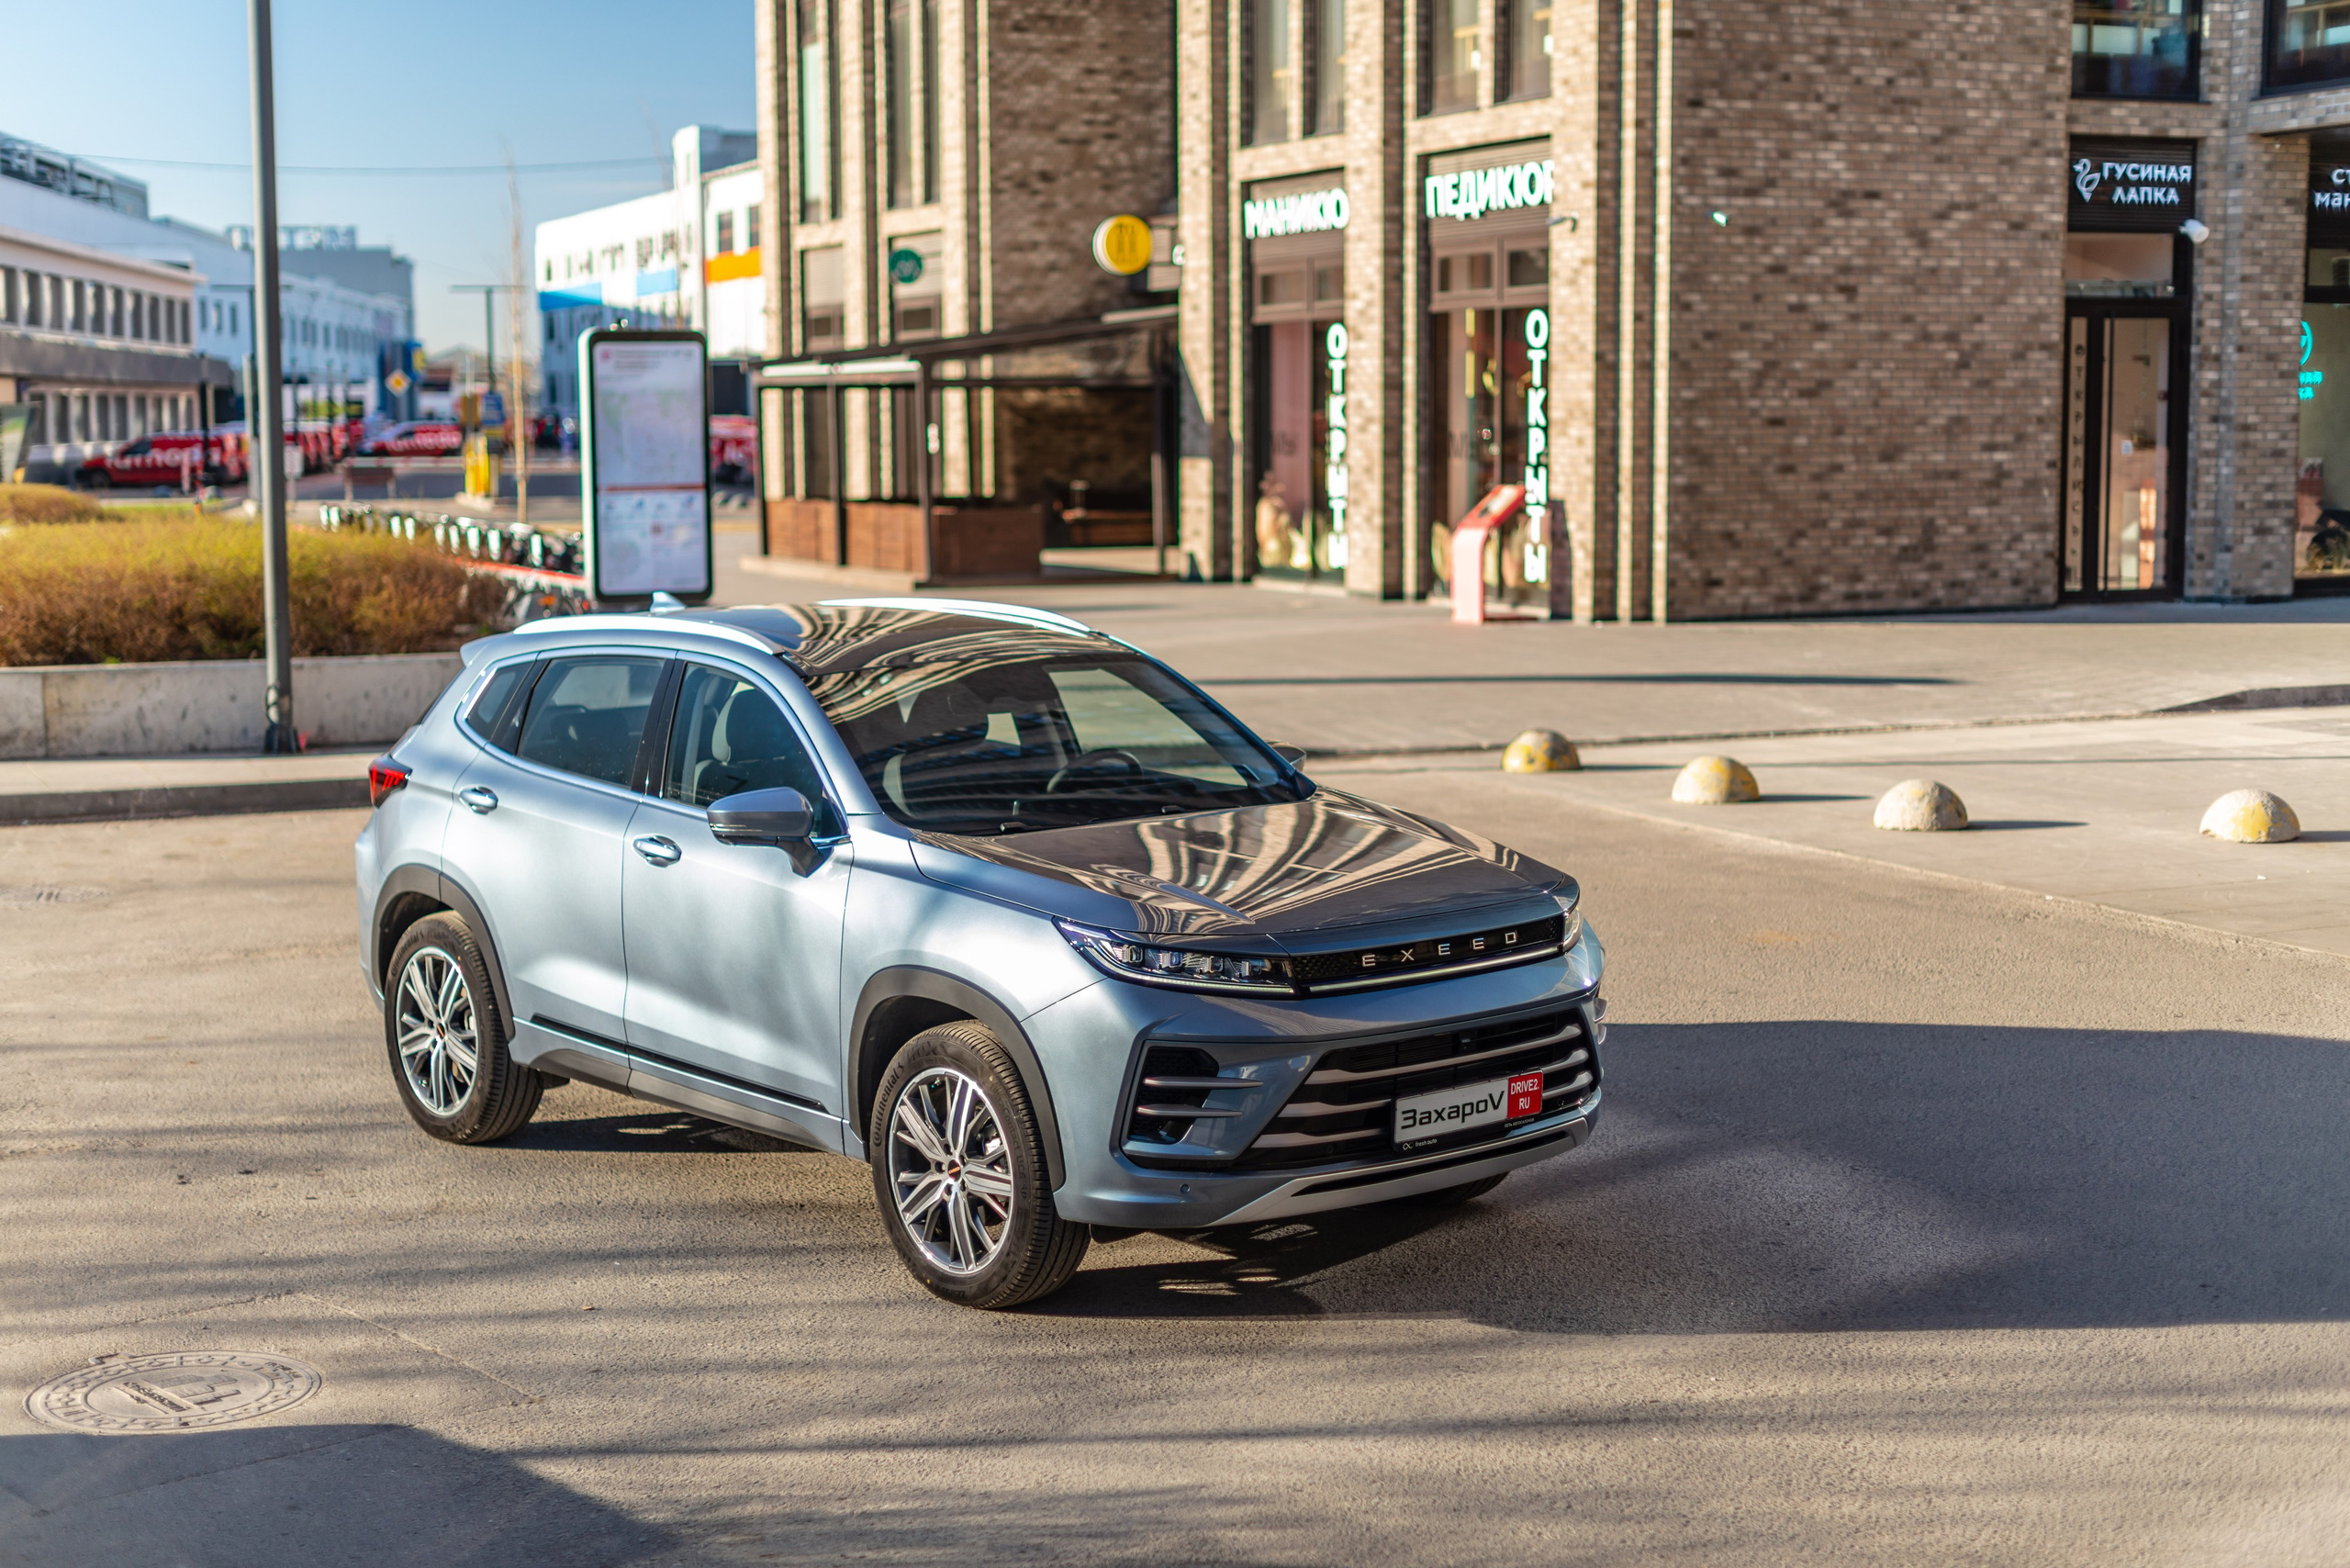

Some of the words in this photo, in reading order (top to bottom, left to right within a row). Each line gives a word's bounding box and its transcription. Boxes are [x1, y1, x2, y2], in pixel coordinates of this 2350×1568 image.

[2102, 162, 2192, 183] ГУСИНАЯ
[2112, 185, 2179, 205] ЛАПКА
[1362, 931, 1518, 968] EXEED
[873, 1067, 900, 1147] Continental
[1518, 1096, 1530, 1110] RU
[1415, 1139, 1427, 1148] fresh
